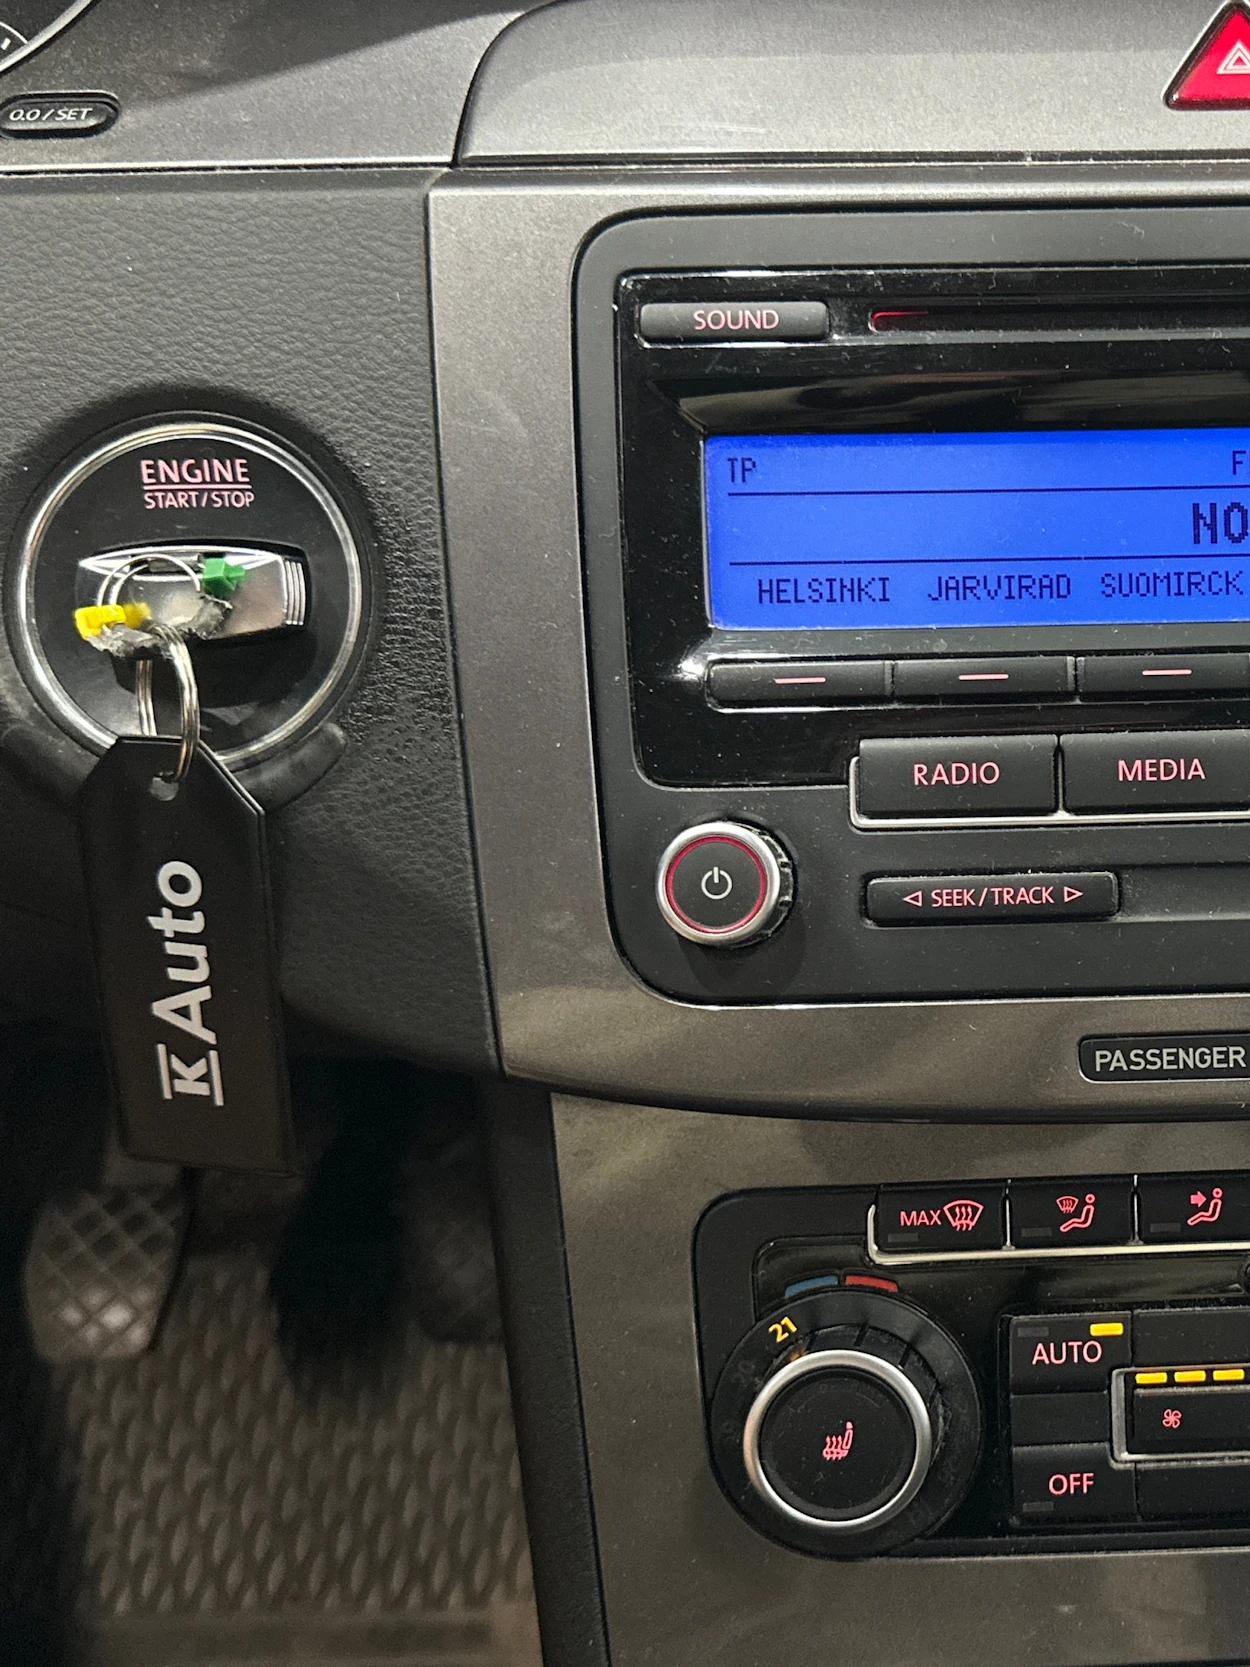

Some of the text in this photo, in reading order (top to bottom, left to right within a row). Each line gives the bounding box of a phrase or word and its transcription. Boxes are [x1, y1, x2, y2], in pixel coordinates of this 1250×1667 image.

[692, 308, 780, 331] SOUND
[140, 458, 250, 484] ENGINE
[726, 457, 757, 483] TP
[758, 576, 890, 604] HELSINKI
[927, 573, 1071, 602] JARVIRAD
[1100, 570, 1244, 598] SUOMIRCK
[913, 761, 1000, 786] RADIO
[1118, 758, 1206, 782] MEDIA
[1095, 1046, 1247, 1072] PASSENGER
[899, 1209, 942, 1227] MAX
[768, 1316, 798, 1343] 21
[1031, 1340, 1102, 1365] AUTO
[1048, 1472, 1094, 1496] OFF
